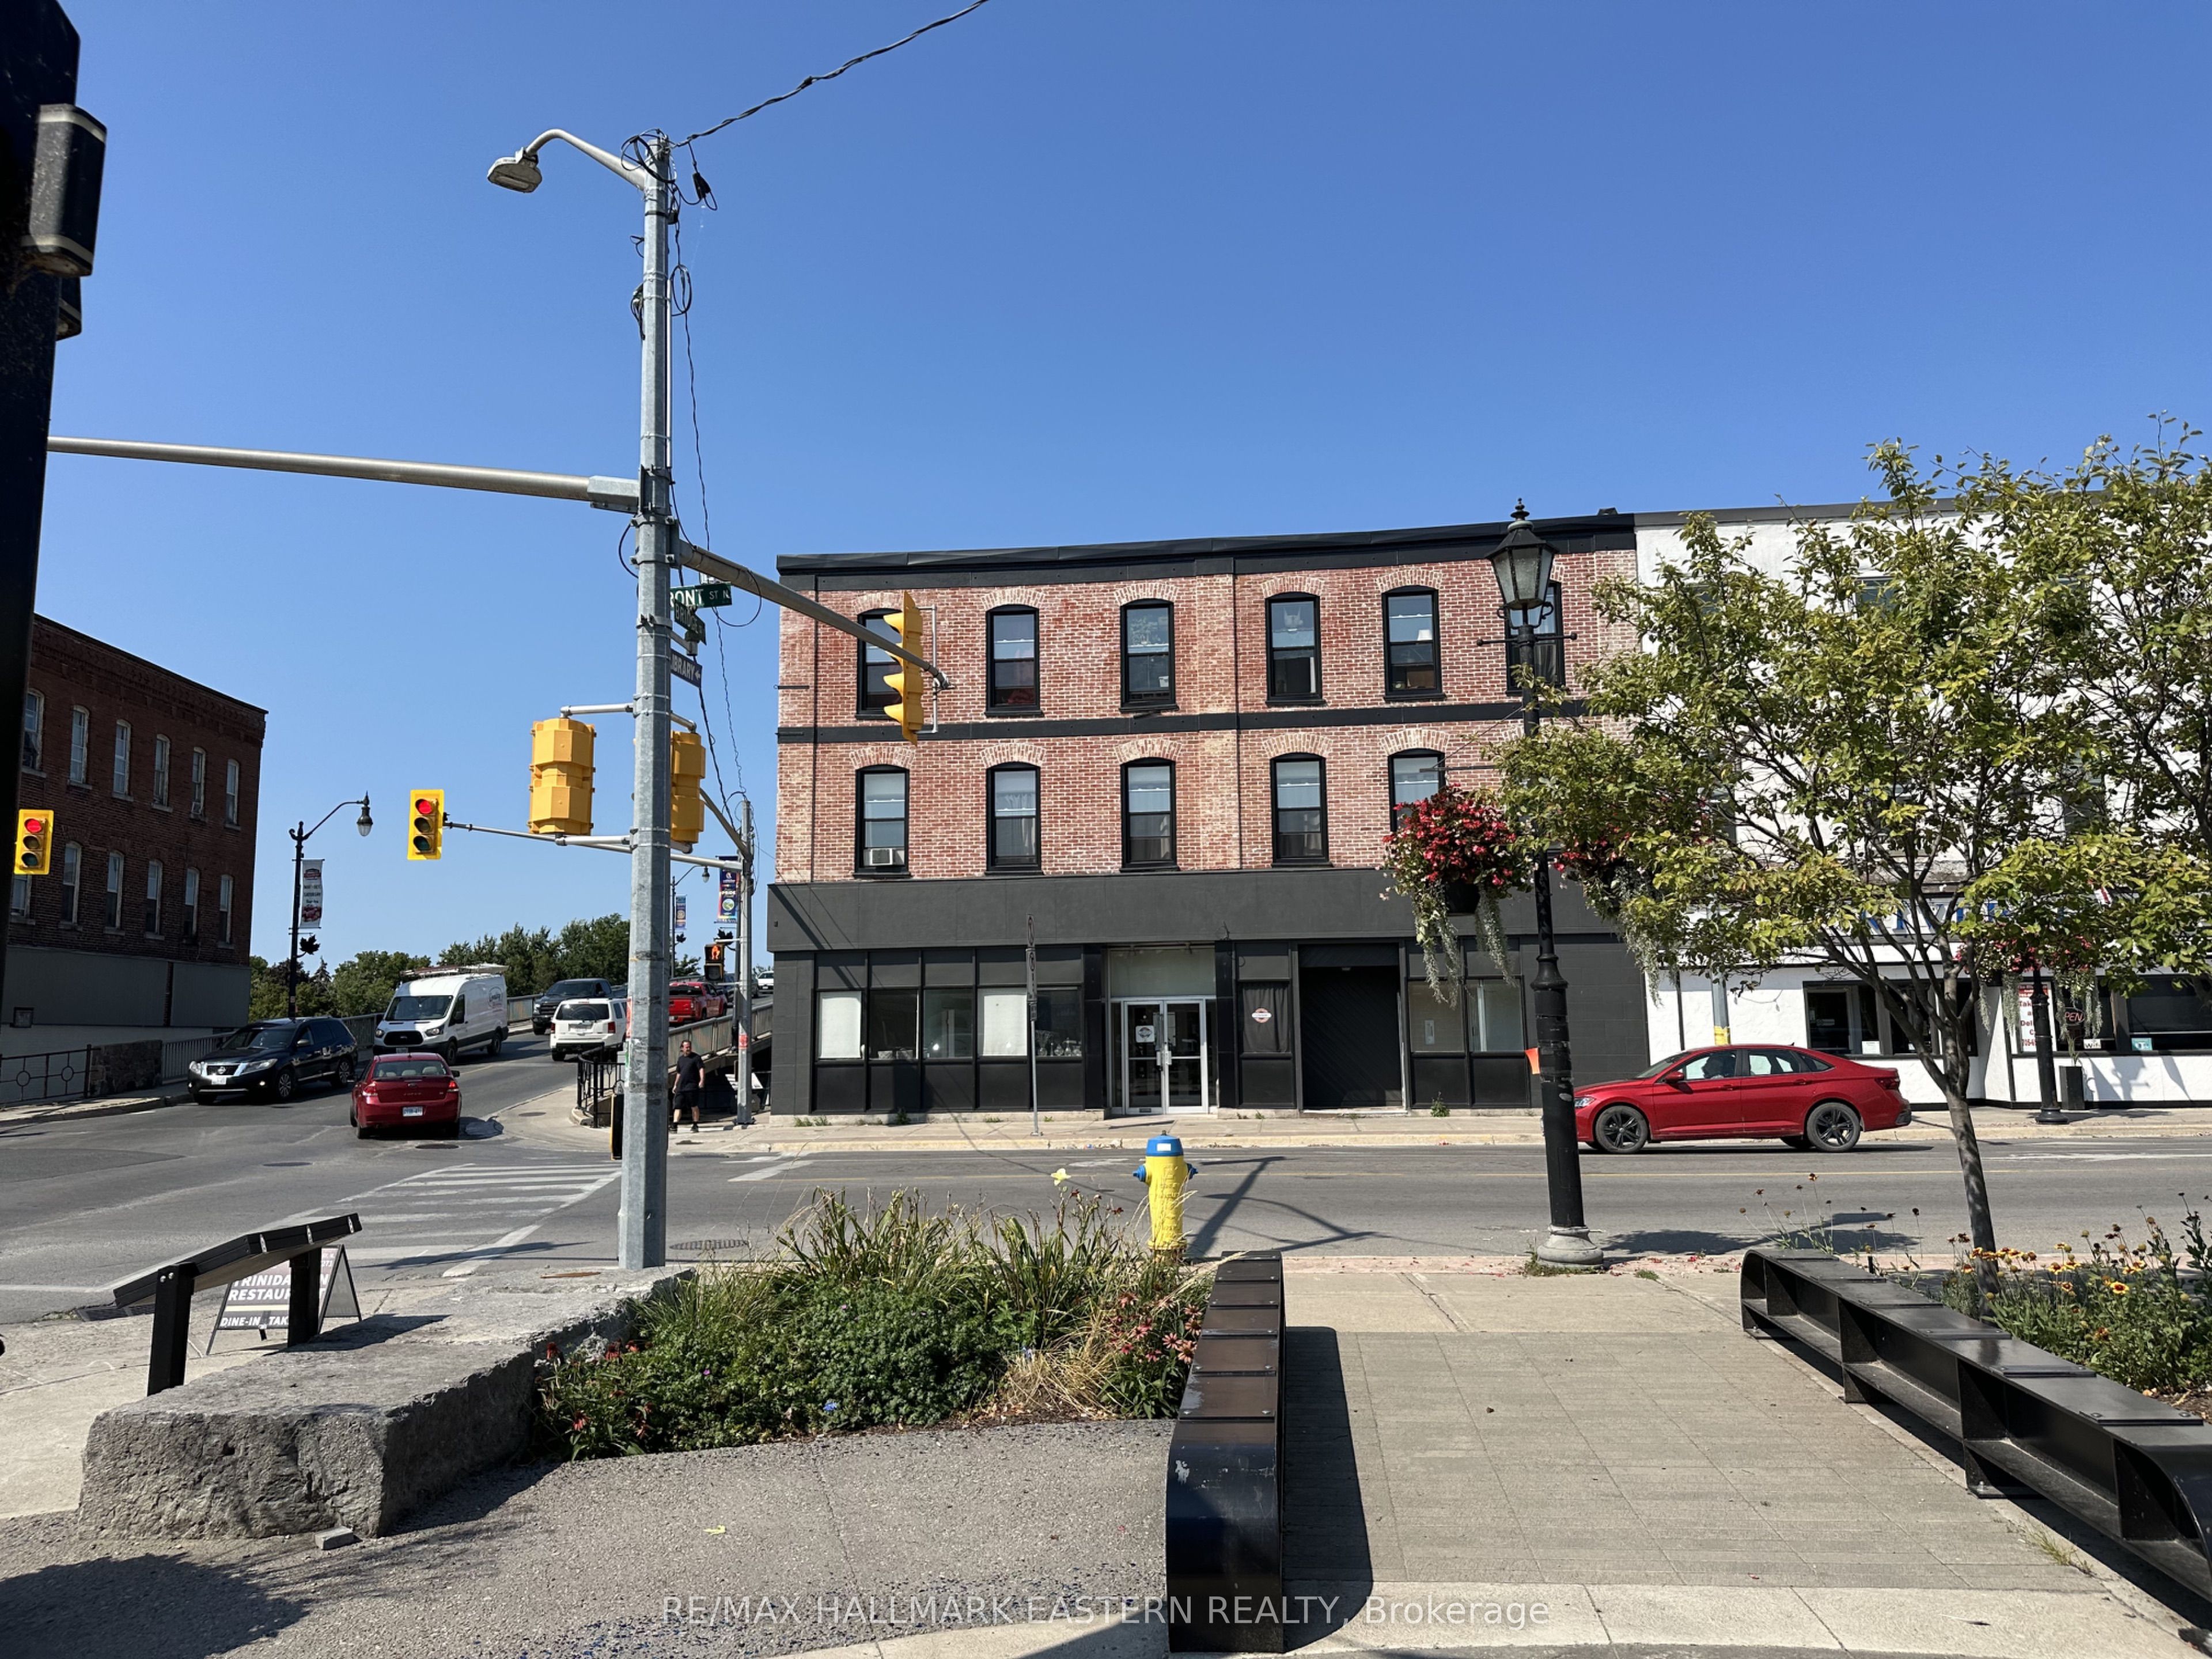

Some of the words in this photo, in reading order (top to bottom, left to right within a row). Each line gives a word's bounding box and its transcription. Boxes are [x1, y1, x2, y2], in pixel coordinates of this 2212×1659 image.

[670, 589, 704, 608] RONT
[709, 590, 719, 600] ST
[2065, 1012, 2083, 1021] PEN
